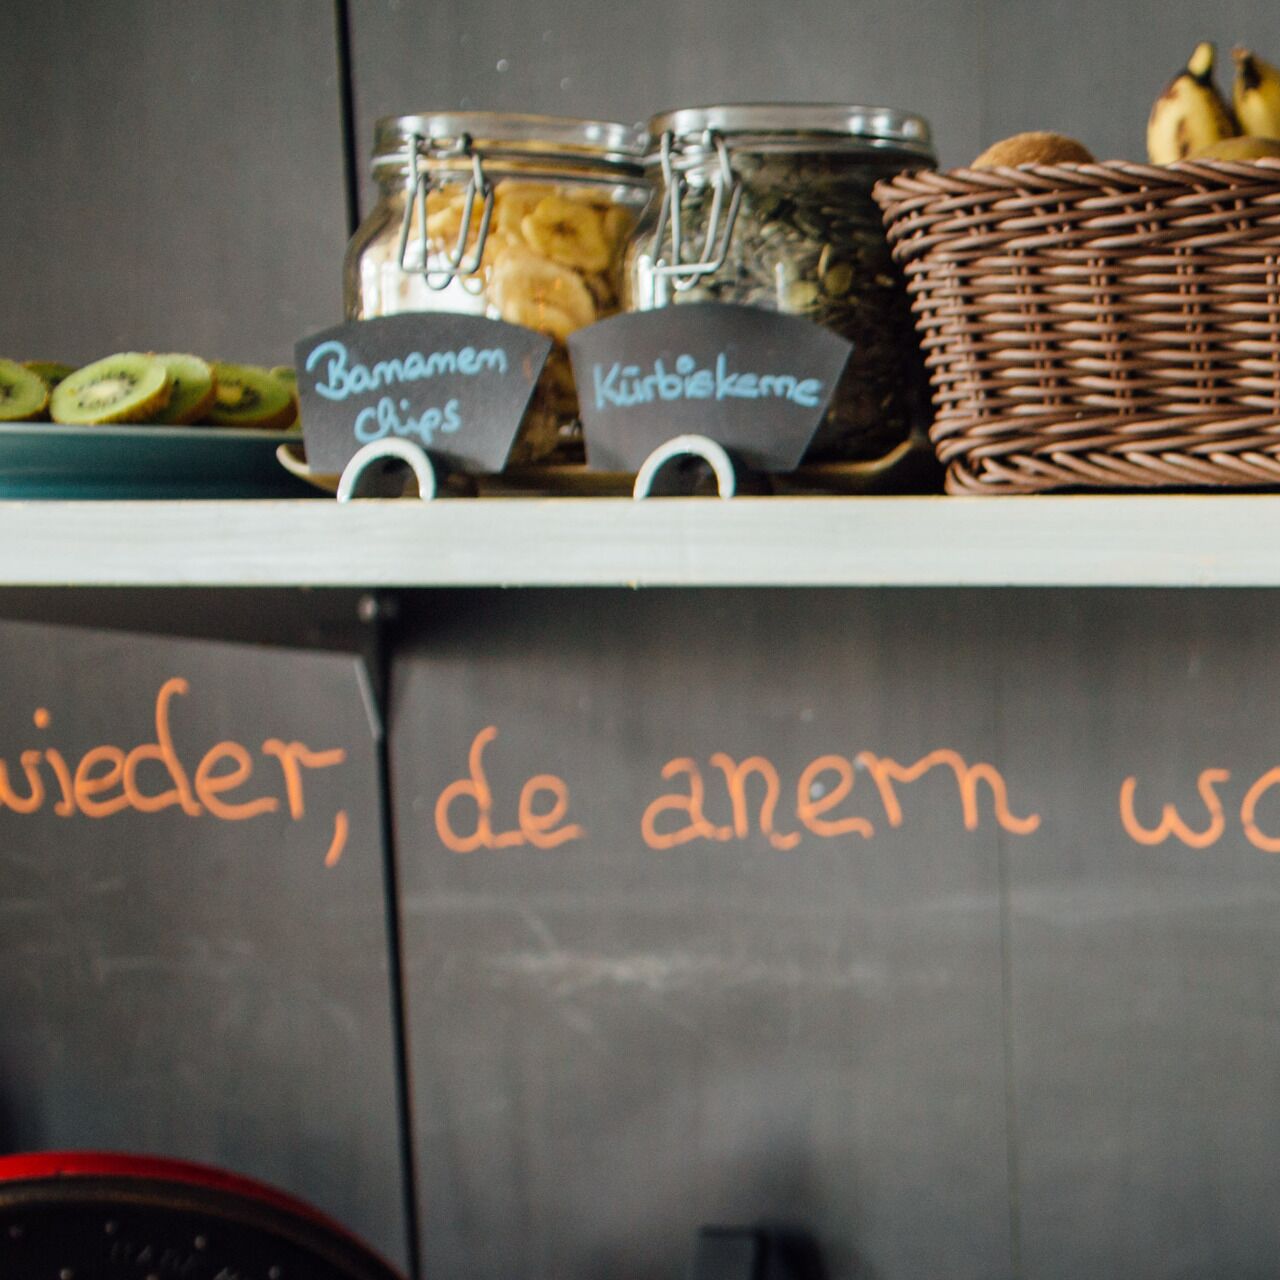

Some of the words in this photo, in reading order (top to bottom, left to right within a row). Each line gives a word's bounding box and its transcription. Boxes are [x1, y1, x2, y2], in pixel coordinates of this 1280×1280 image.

[305, 340, 507, 400] Bananen
[435, 727, 586, 852] de
[641, 749, 1041, 850] anern
